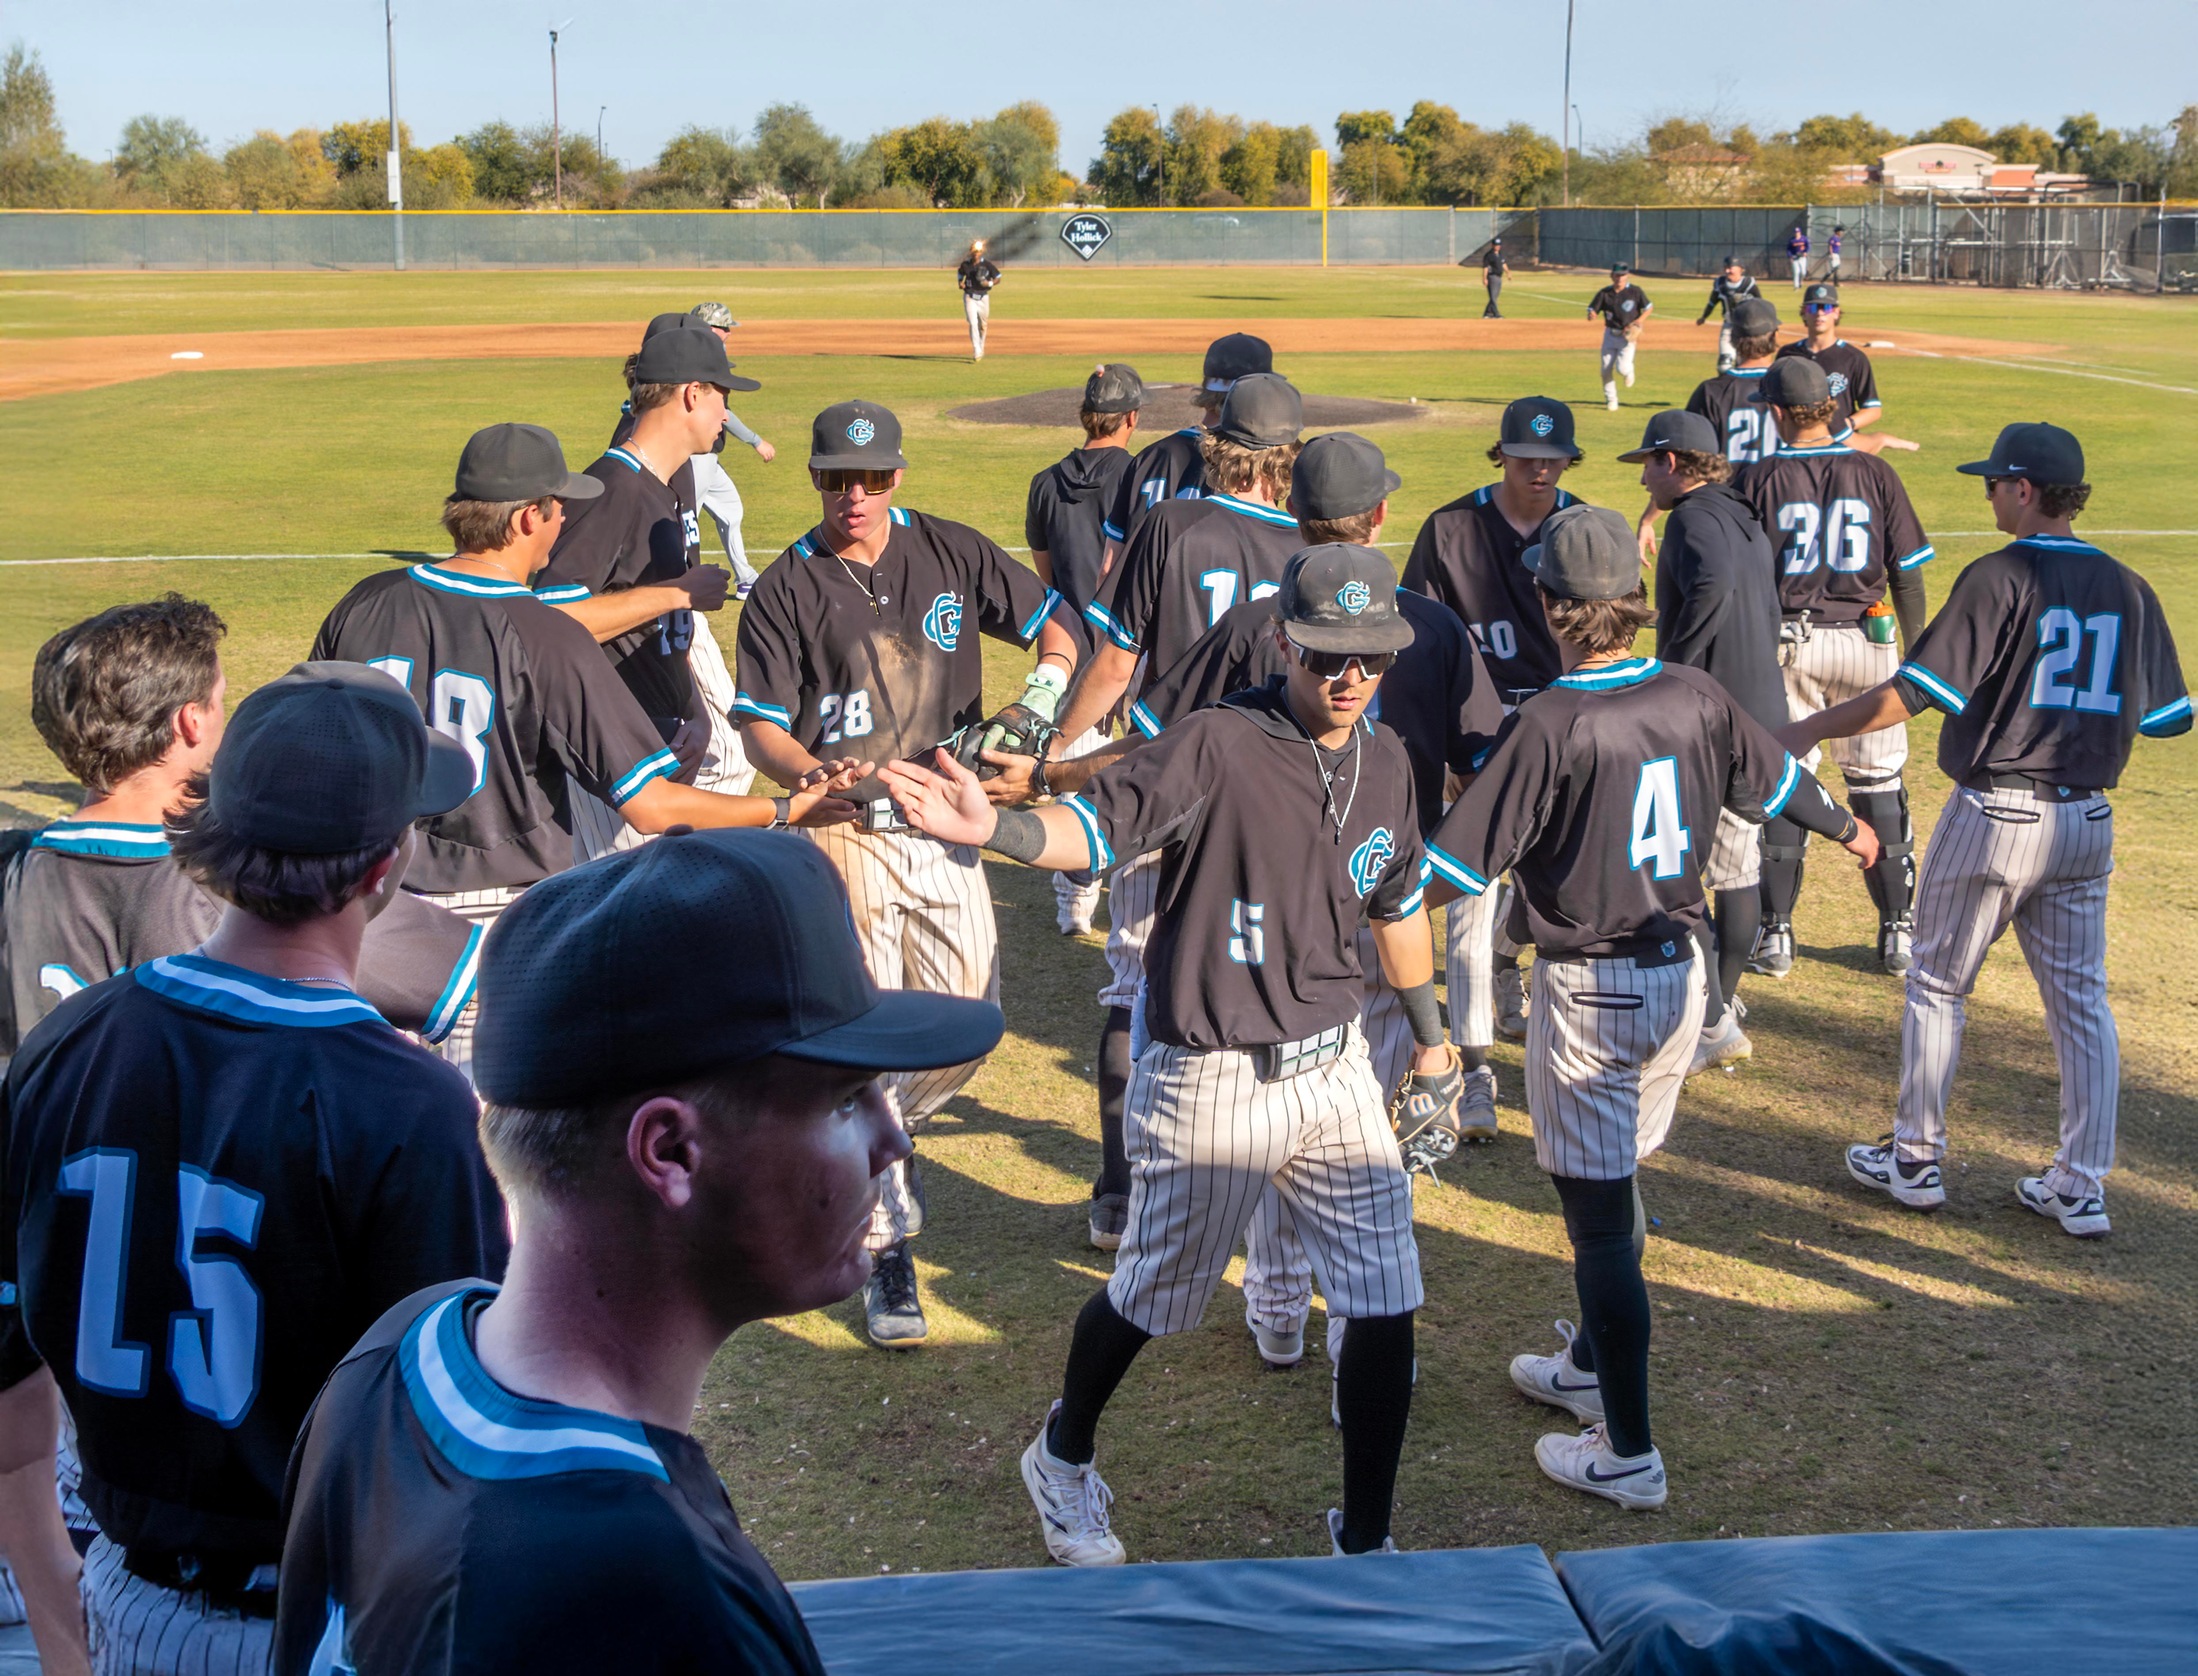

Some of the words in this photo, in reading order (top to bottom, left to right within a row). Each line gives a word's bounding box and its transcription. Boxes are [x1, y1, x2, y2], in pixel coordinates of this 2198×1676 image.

[1071, 232, 1102, 242] Hollick
[1074, 221, 1097, 233] Tyler
[1777, 498, 1871, 576] 36
[1200, 567, 1280, 629] 1
[2029, 605, 2122, 716] 21
[819, 688, 874, 745] 28
[1627, 755, 1691, 881] 4
[1228, 898, 1265, 967] 5
[58, 1146, 265, 1429] 15
